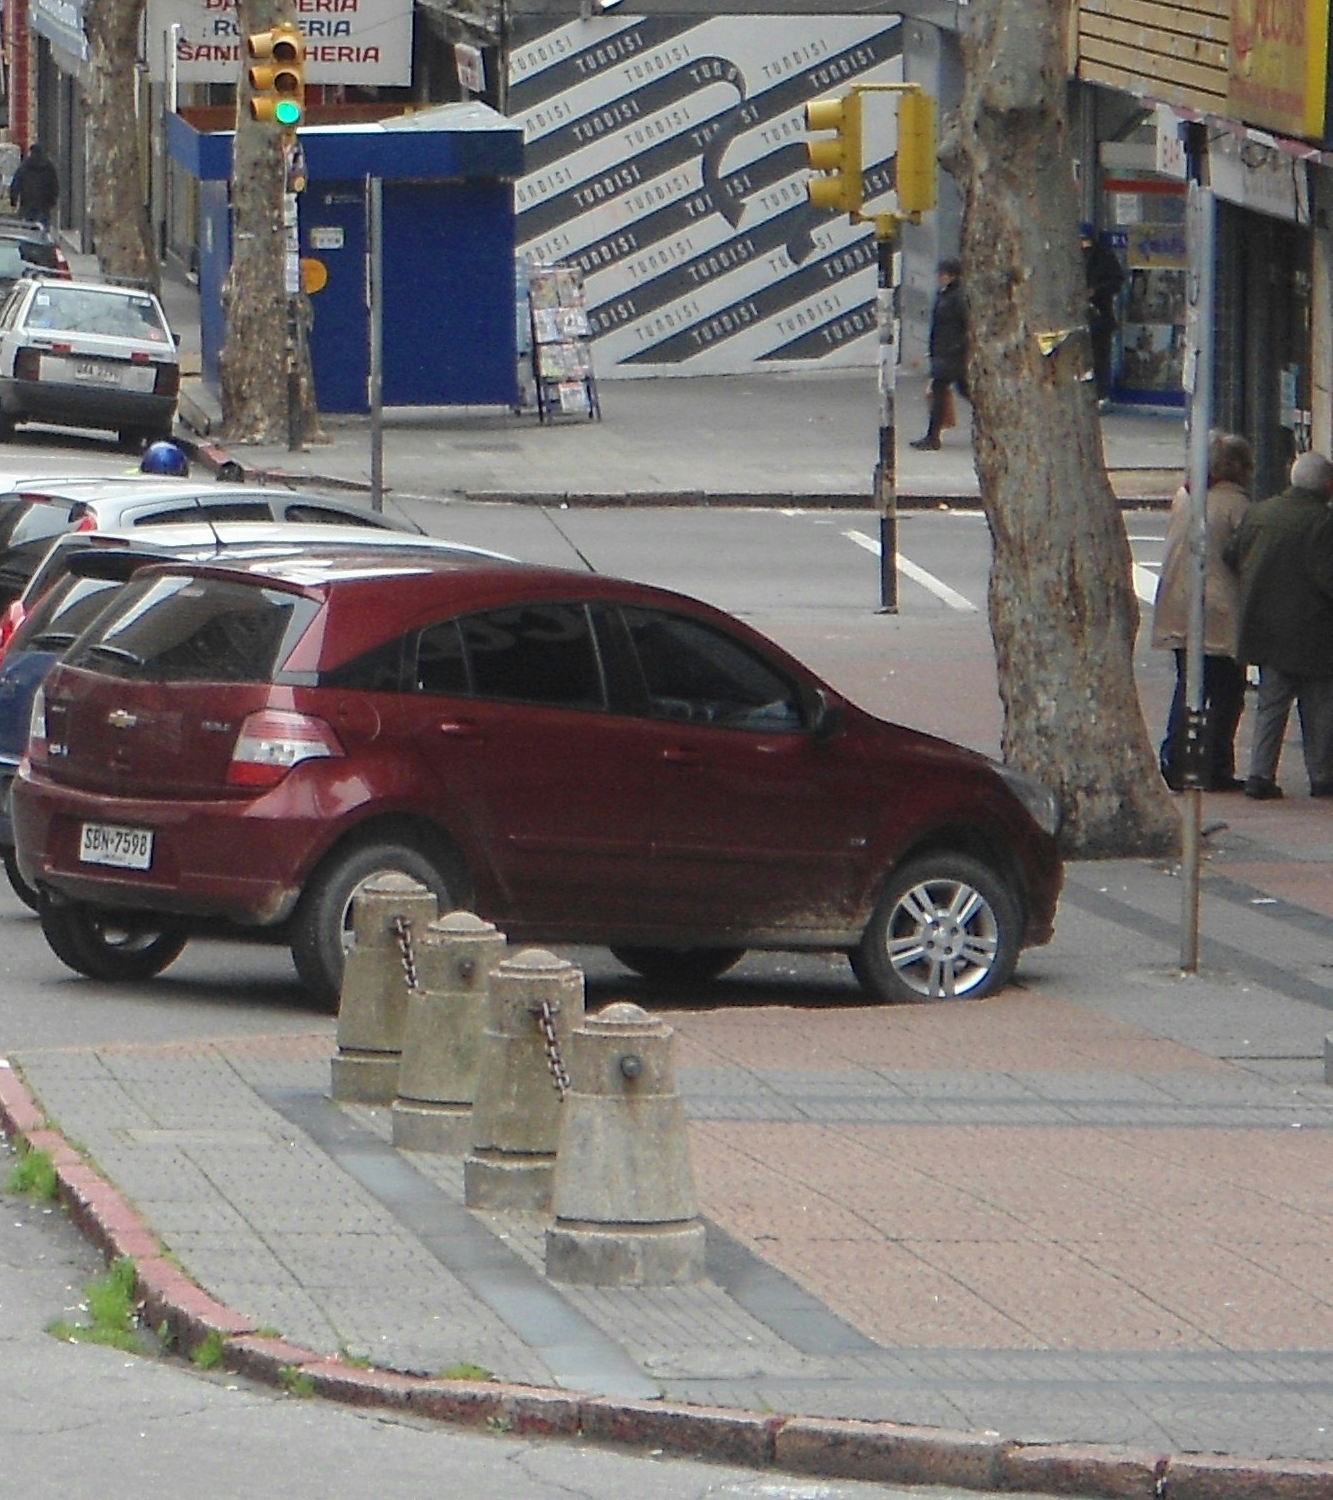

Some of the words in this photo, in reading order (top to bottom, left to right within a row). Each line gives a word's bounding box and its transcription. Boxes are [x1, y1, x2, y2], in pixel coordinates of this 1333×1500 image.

[576, 32, 644, 73] TUNDISI
[624, 43, 691, 83] TUNDISI
[762, 39, 829, 79] TUNDISI
[809, 47, 877, 88] TUNDISI
[526, 101, 572, 133] NDISI
[573, 99, 640, 141] TUNDISI
[624, 107, 691, 148] TUNDISI
[517, 167, 573, 202] UNDISI
[574, 164, 641, 207] TUNDISI
[624, 173, 691, 214] TUNDISI
[525, 234, 570, 264] NDISI
[629, 238, 694, 279] TUNDISI
[688, 239, 756, 281] TUNDISI
[636, 301, 701, 341] TUNDISI
[691, 303, 758, 345] TUNDISI
[776, 295, 842, 335] TUNDISI
